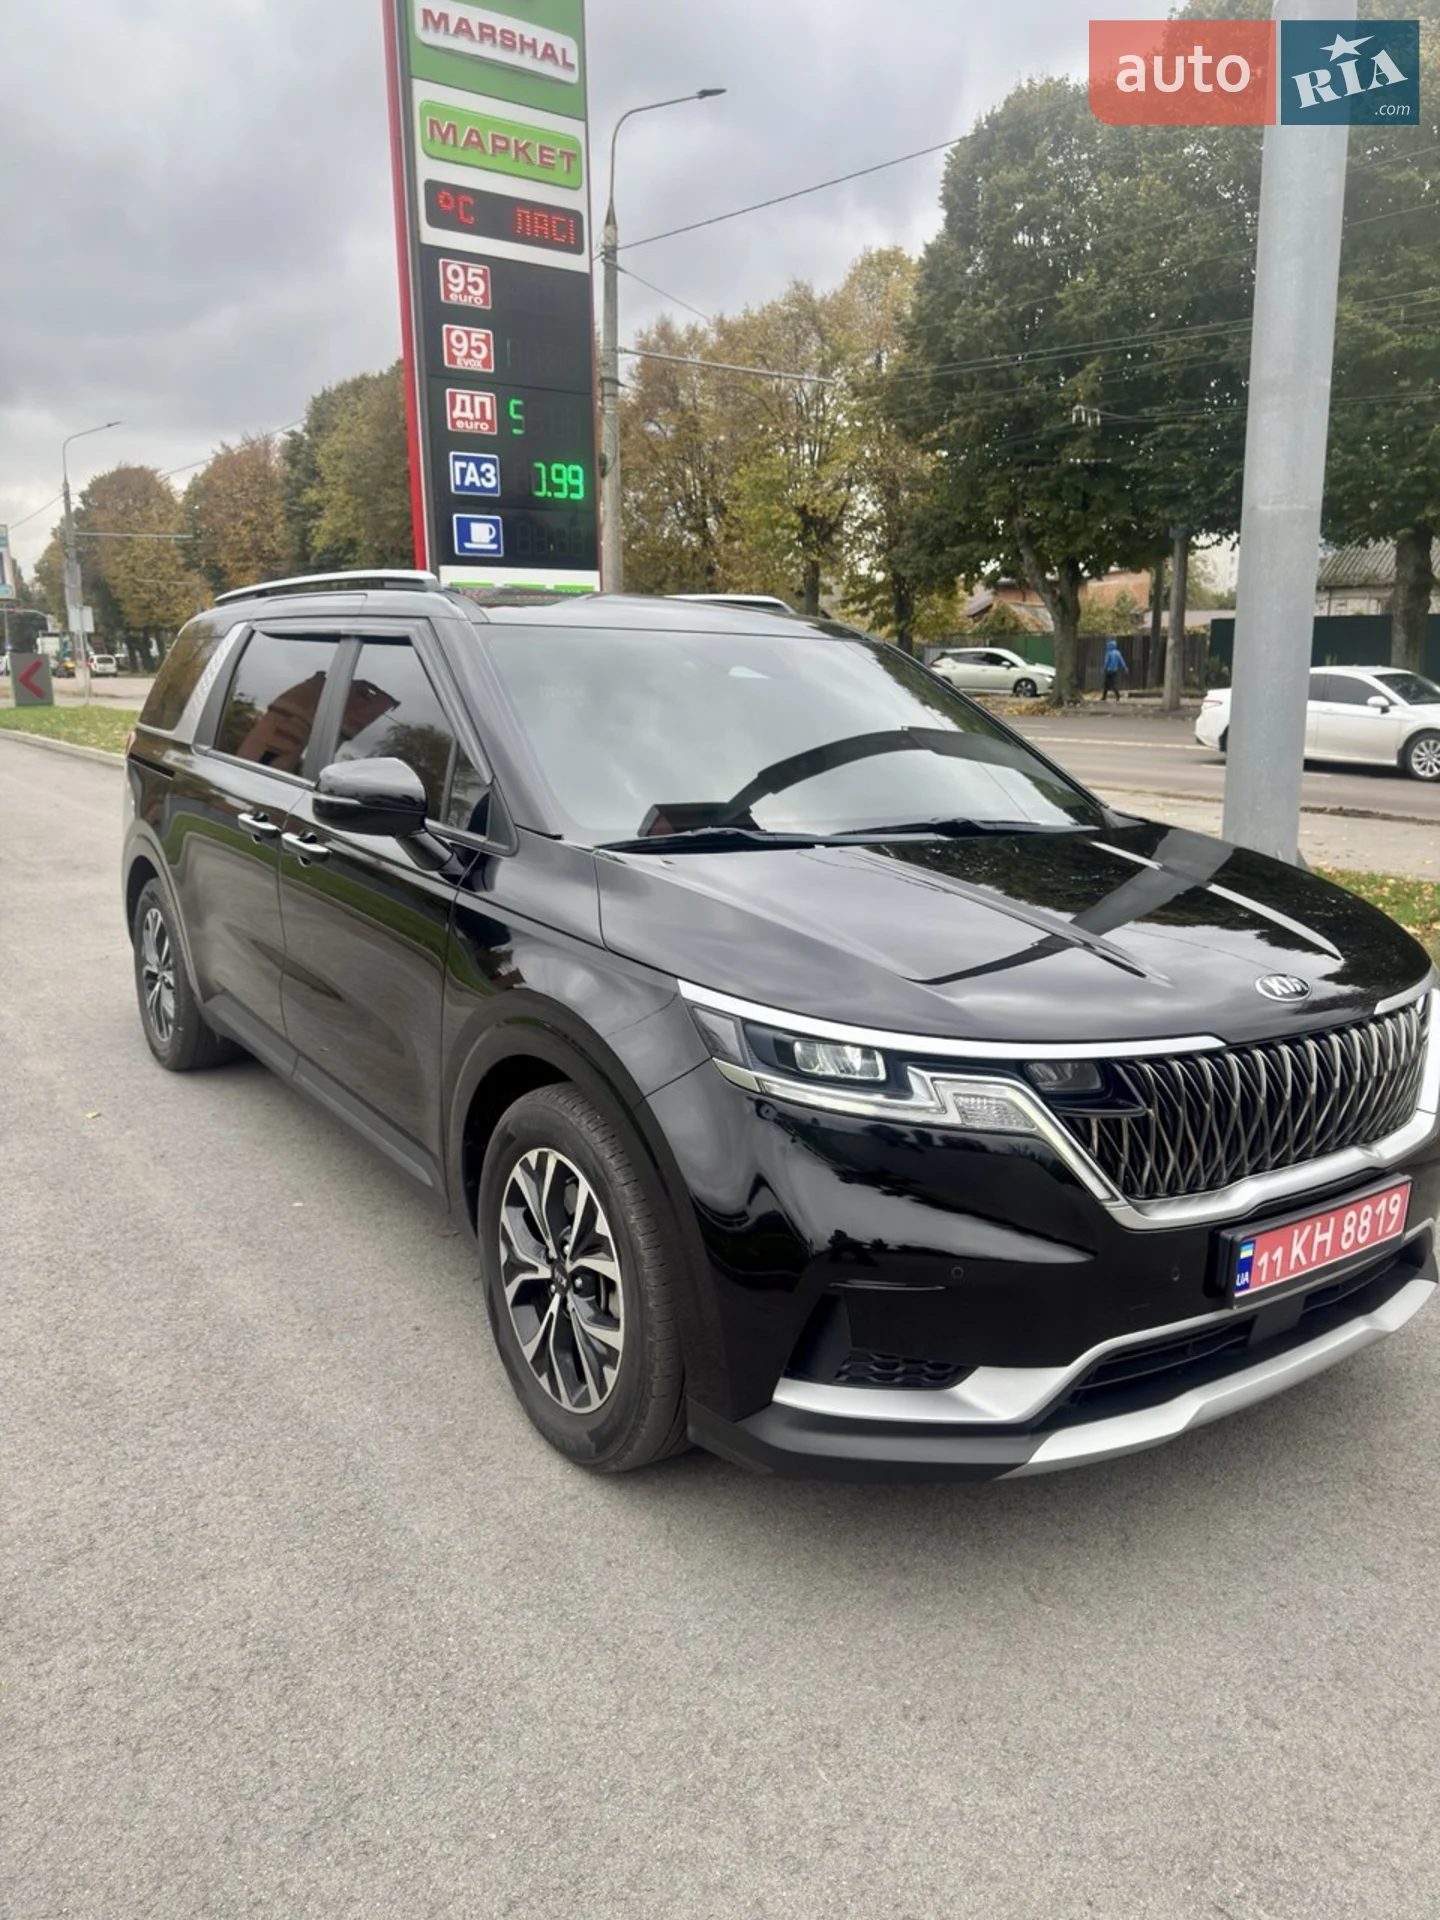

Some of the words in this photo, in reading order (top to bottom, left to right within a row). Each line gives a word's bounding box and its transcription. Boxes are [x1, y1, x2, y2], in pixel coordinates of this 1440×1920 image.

[421, 7, 576, 72] MARSHAL
[427, 116, 577, 175] МАРКЕТ
[446, 263, 486, 297] 95
[449, 293, 484, 305] euro
[450, 329, 489, 360] 95
[452, 393, 492, 420] ДП
[456, 419, 489, 432] euro
[454, 461, 497, 489] ГАЗ
[1340, 1193, 1402, 1251] 8819
[1235, 1272, 1250, 1287] UA
